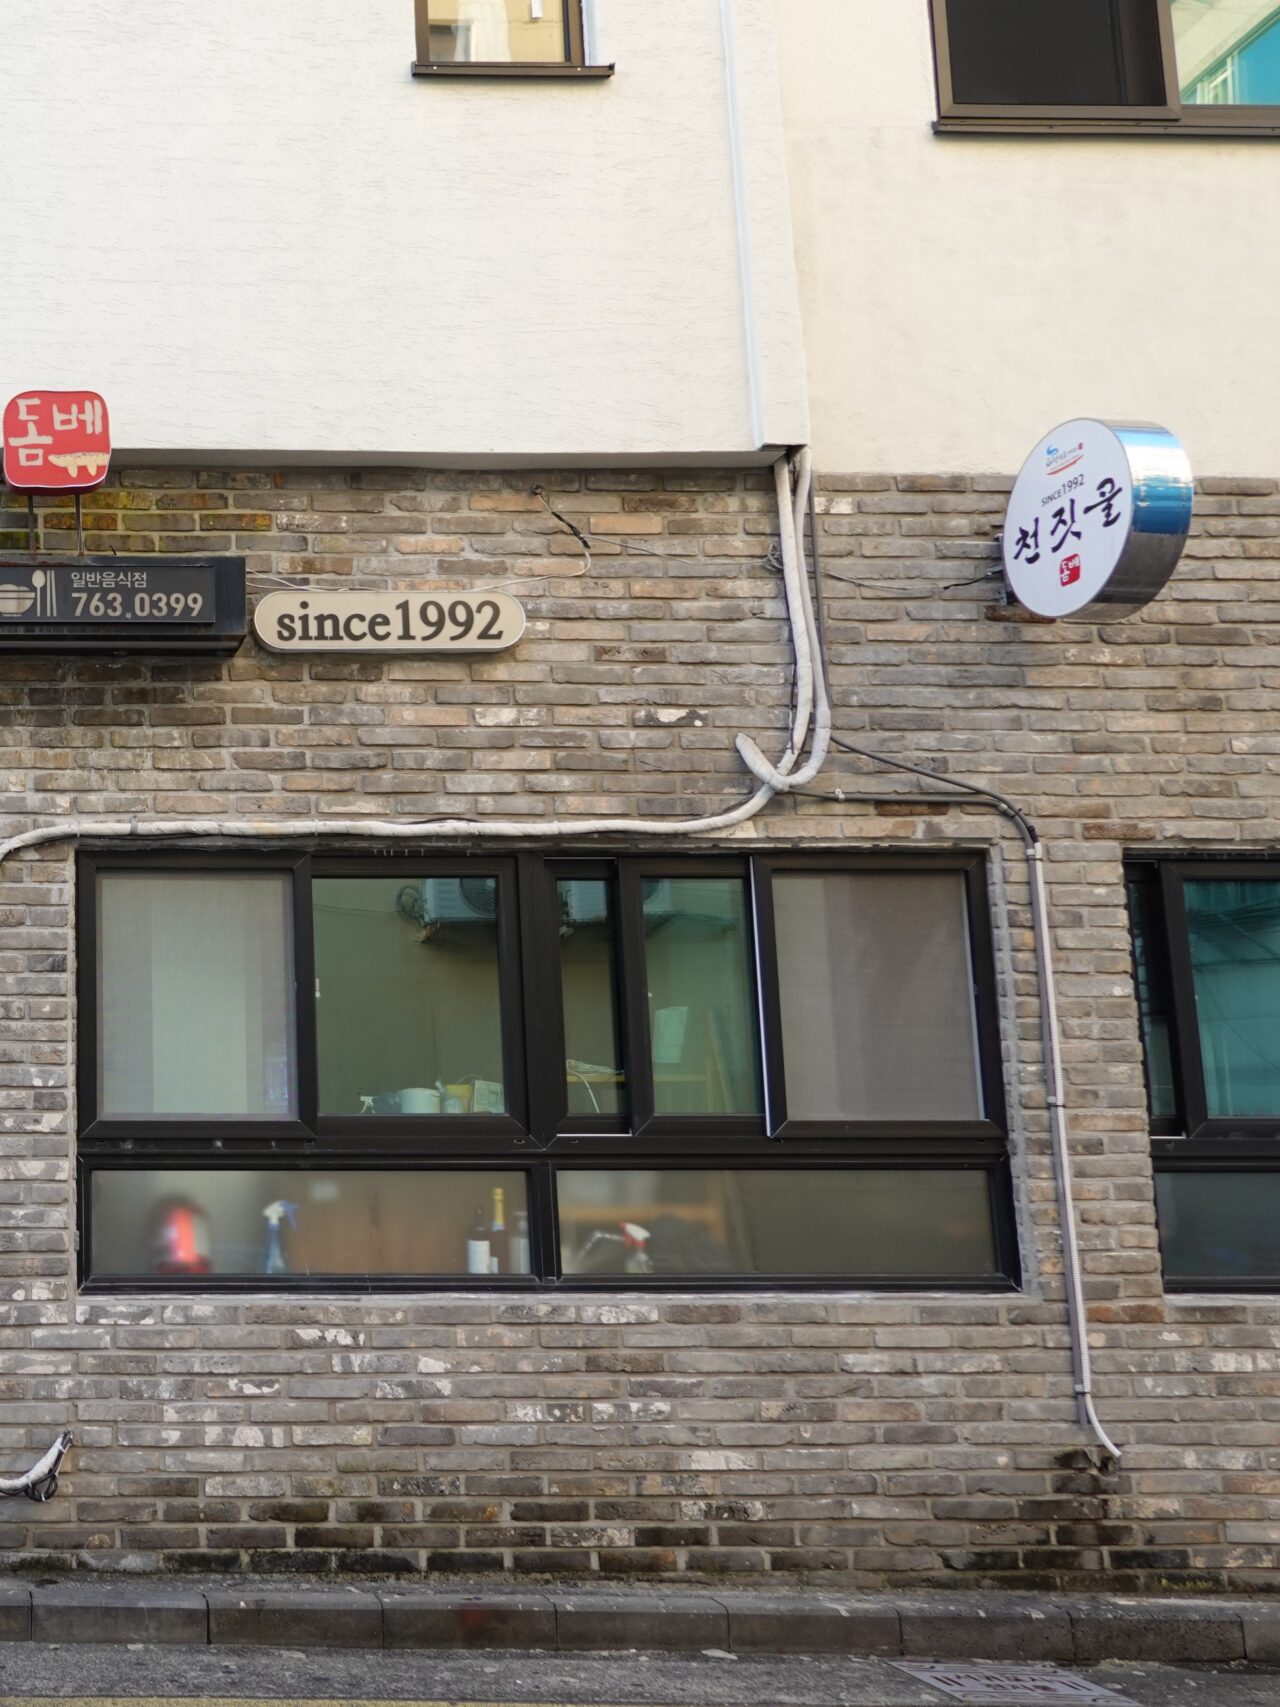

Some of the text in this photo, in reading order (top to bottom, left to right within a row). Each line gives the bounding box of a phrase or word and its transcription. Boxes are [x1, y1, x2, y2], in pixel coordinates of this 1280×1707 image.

[1012, 477, 1123, 565] 천짓골
[71, 571, 147, 588] 일반음식점
[71, 592, 203, 619] 763.0399
[276, 599, 504, 642] since1992
